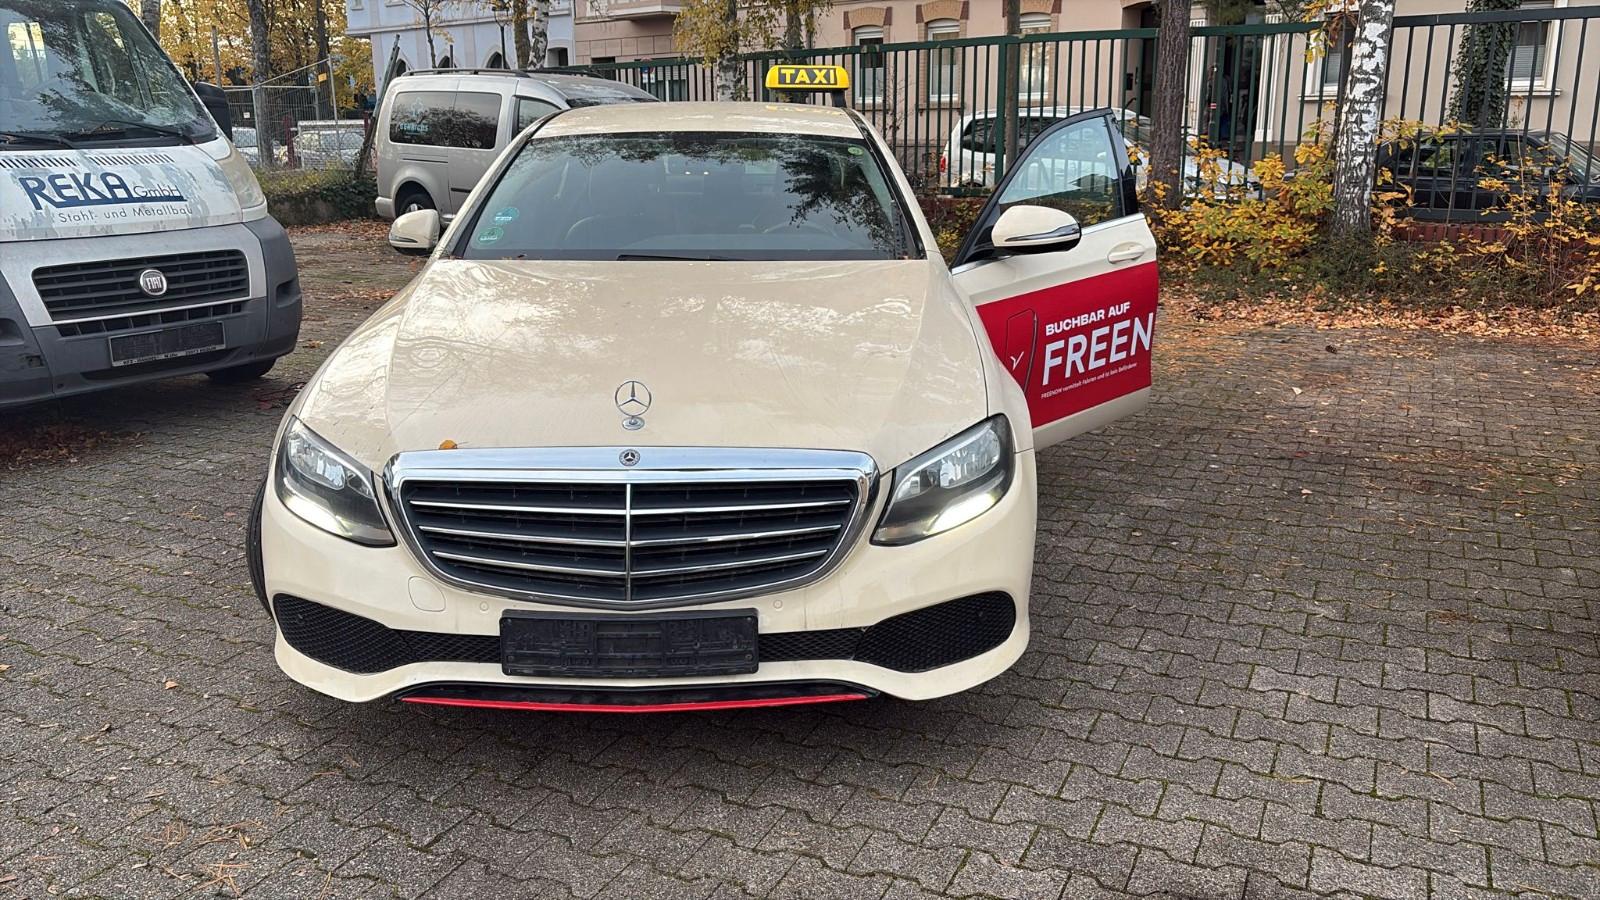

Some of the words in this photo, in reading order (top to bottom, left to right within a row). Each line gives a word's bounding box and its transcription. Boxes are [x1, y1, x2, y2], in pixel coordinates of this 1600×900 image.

[781, 69, 835, 84] TAXI
[18, 172, 133, 210] REKA
[133, 184, 180, 197] GmbH
[59, 209, 99, 223] Stahl-
[104, 208, 127, 218] und
[133, 204, 193, 217] Metallbau
[1045, 309, 1105, 336] BUCHBAR
[1108, 301, 1131, 319] AUF
